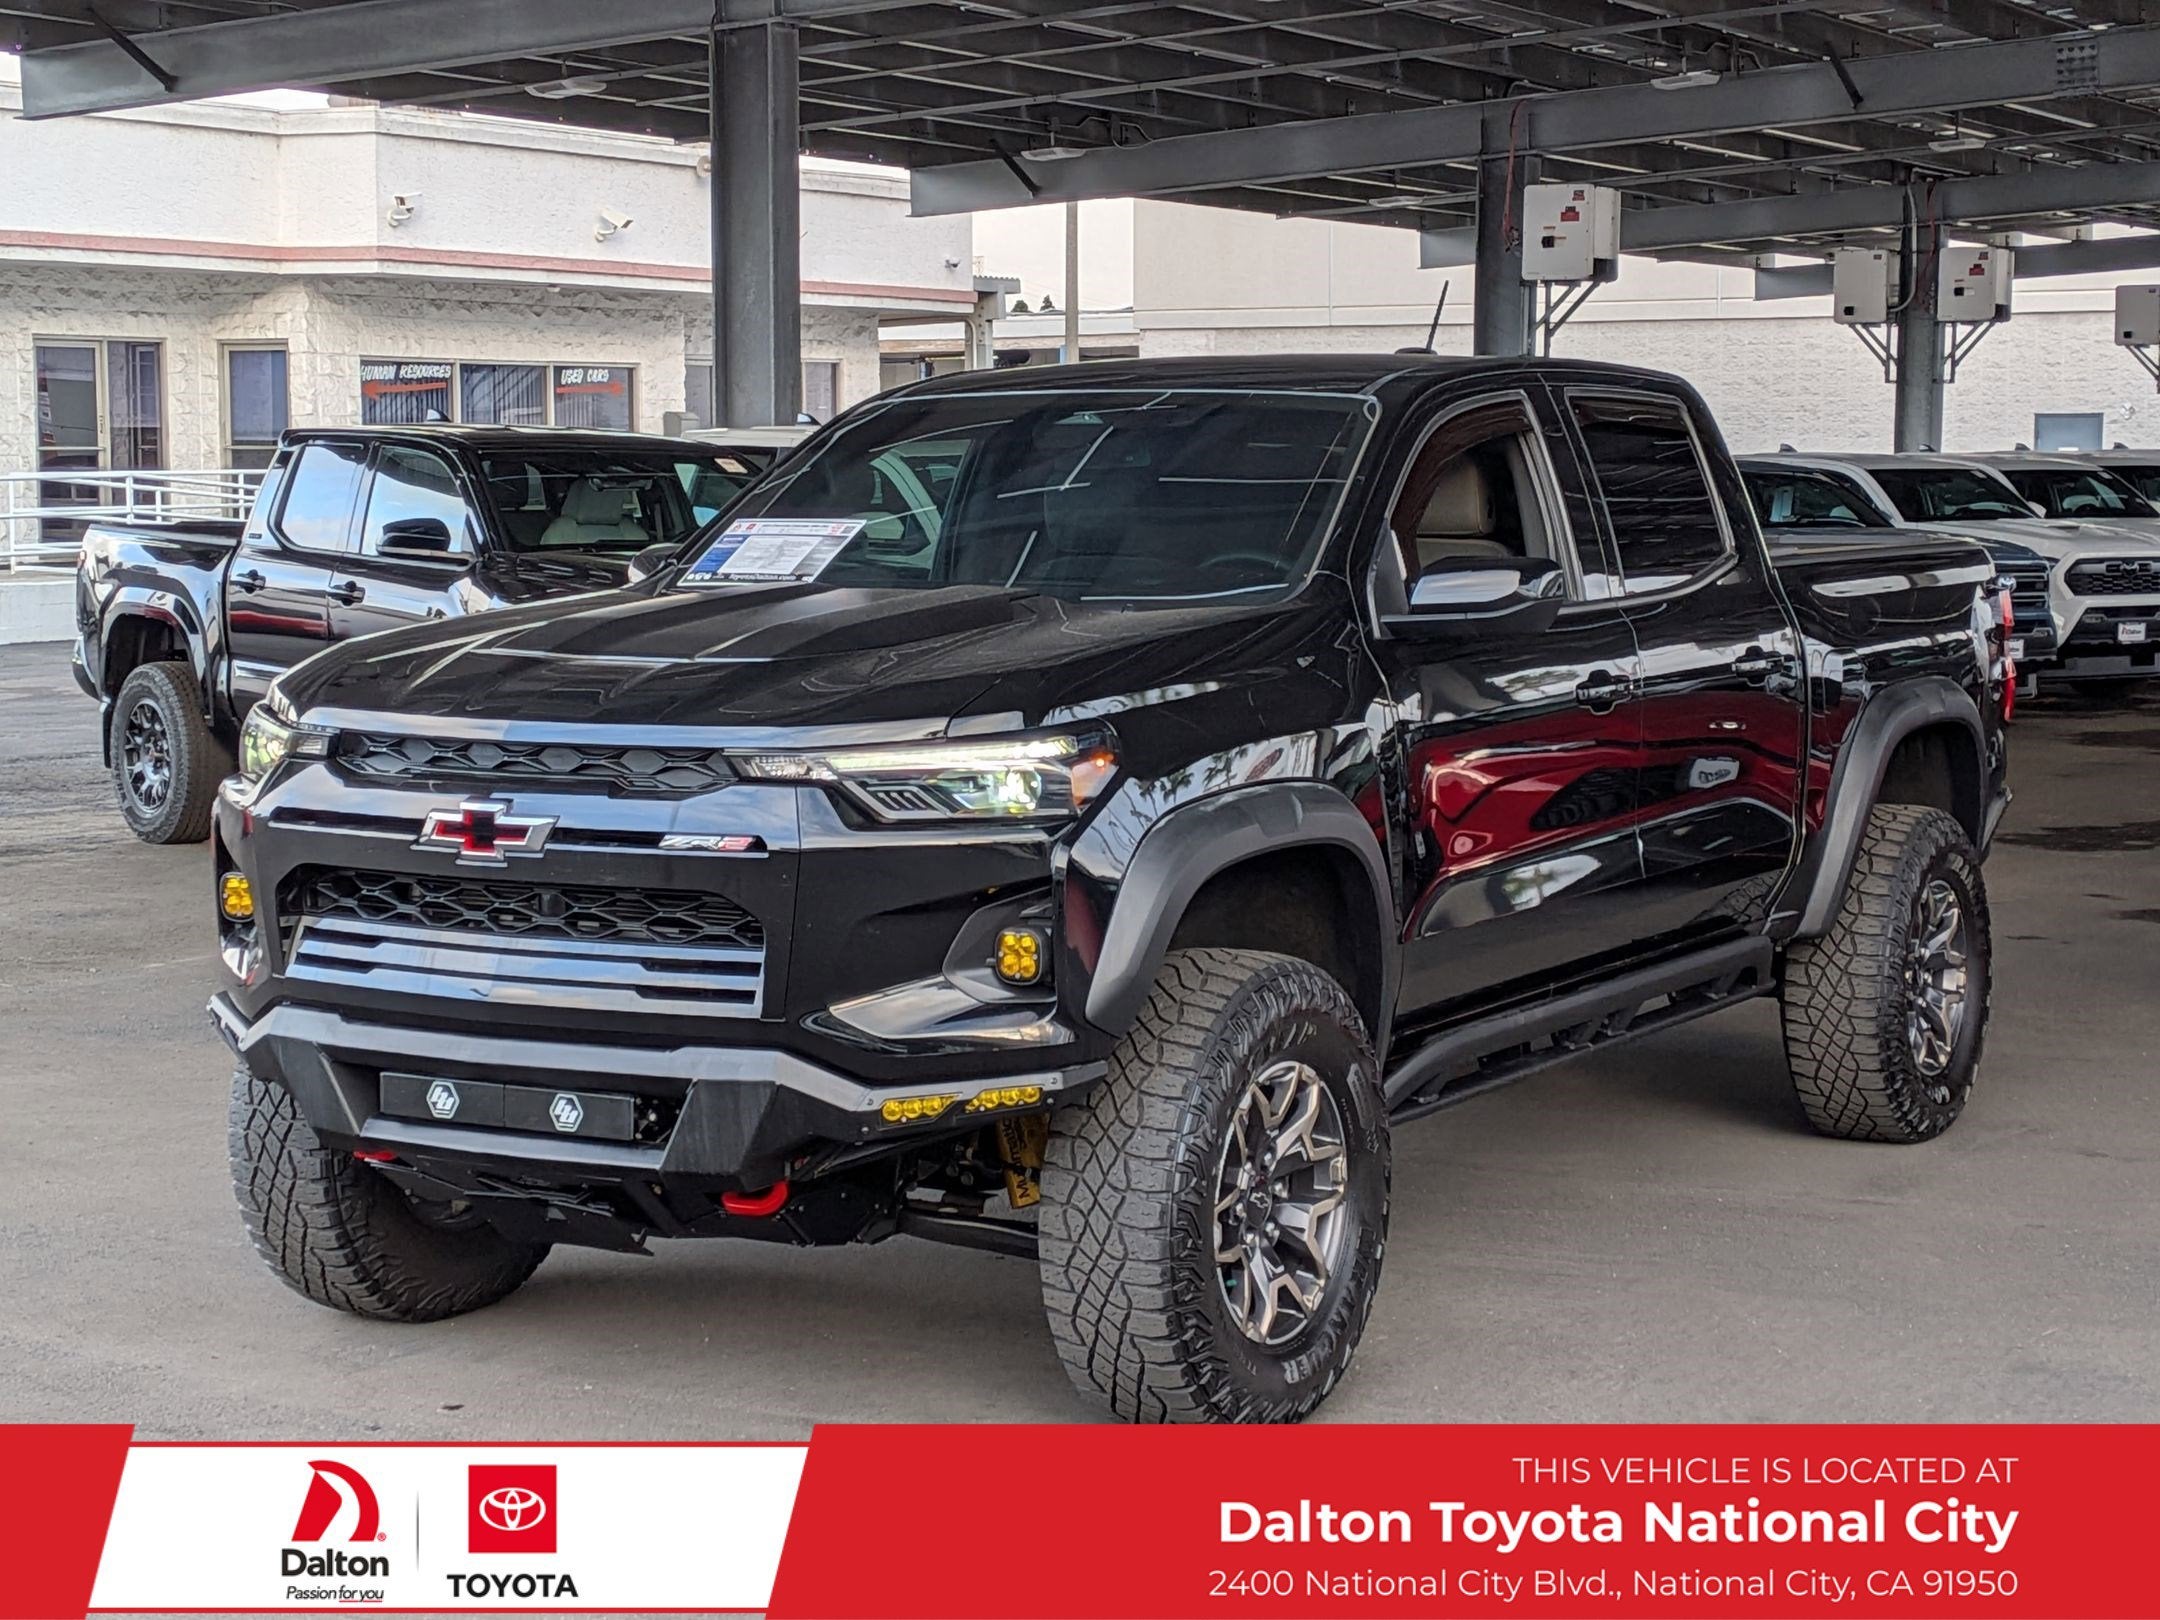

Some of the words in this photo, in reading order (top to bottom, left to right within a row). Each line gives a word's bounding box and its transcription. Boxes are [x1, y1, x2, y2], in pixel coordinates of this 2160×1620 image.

[360, 364, 397, 381] HUMAN
[399, 363, 452, 379] RESOURCES
[561, 368, 583, 385] USED
[586, 368, 609, 382] CARS
